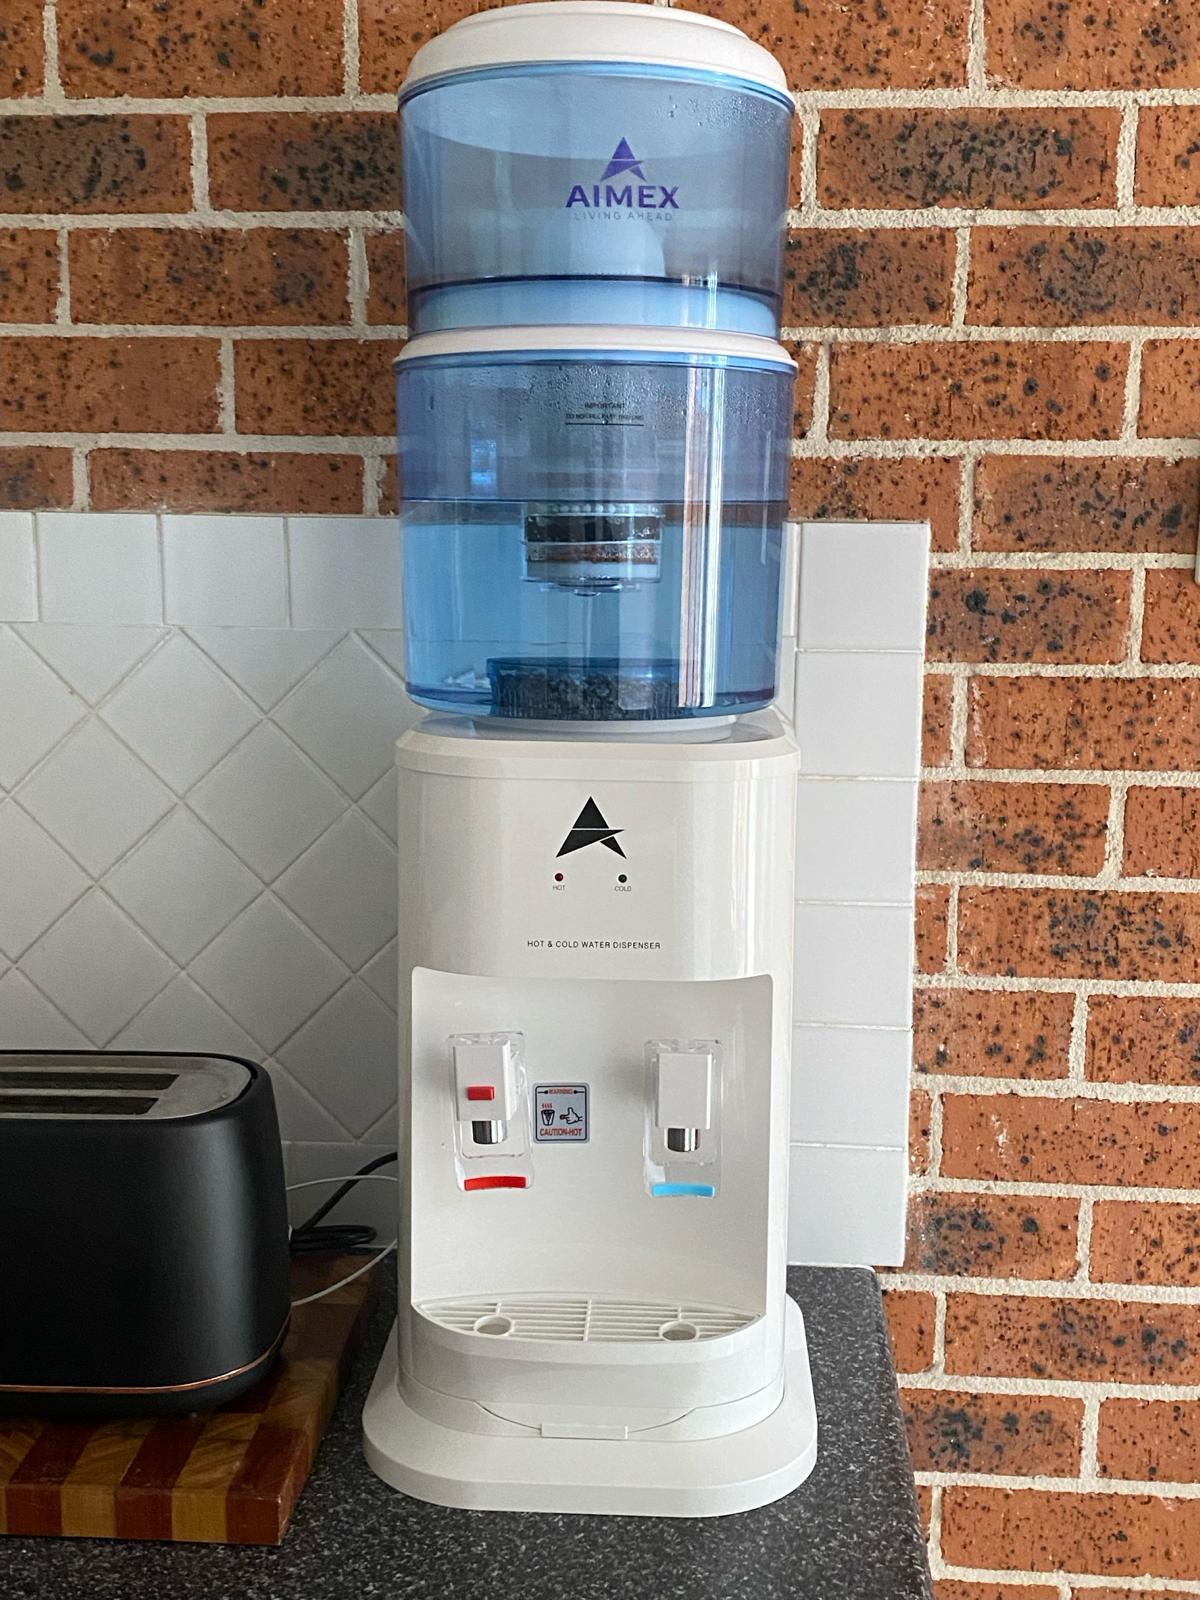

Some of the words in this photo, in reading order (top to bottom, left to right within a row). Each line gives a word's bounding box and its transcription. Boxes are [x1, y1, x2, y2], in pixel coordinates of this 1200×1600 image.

[565, 185, 680, 208] AIMEX
[574, 211, 621, 221] LIVING
[627, 212, 673, 221] AHEAD
[527, 940, 545, 948] HOT
[547, 940, 553, 948] &
[555, 940, 579, 948] COLD
[581, 941, 611, 949] WATER
[612, 941, 661, 950] DISPENSER
[539, 1128, 583, 1137] CAUTION-HOT
